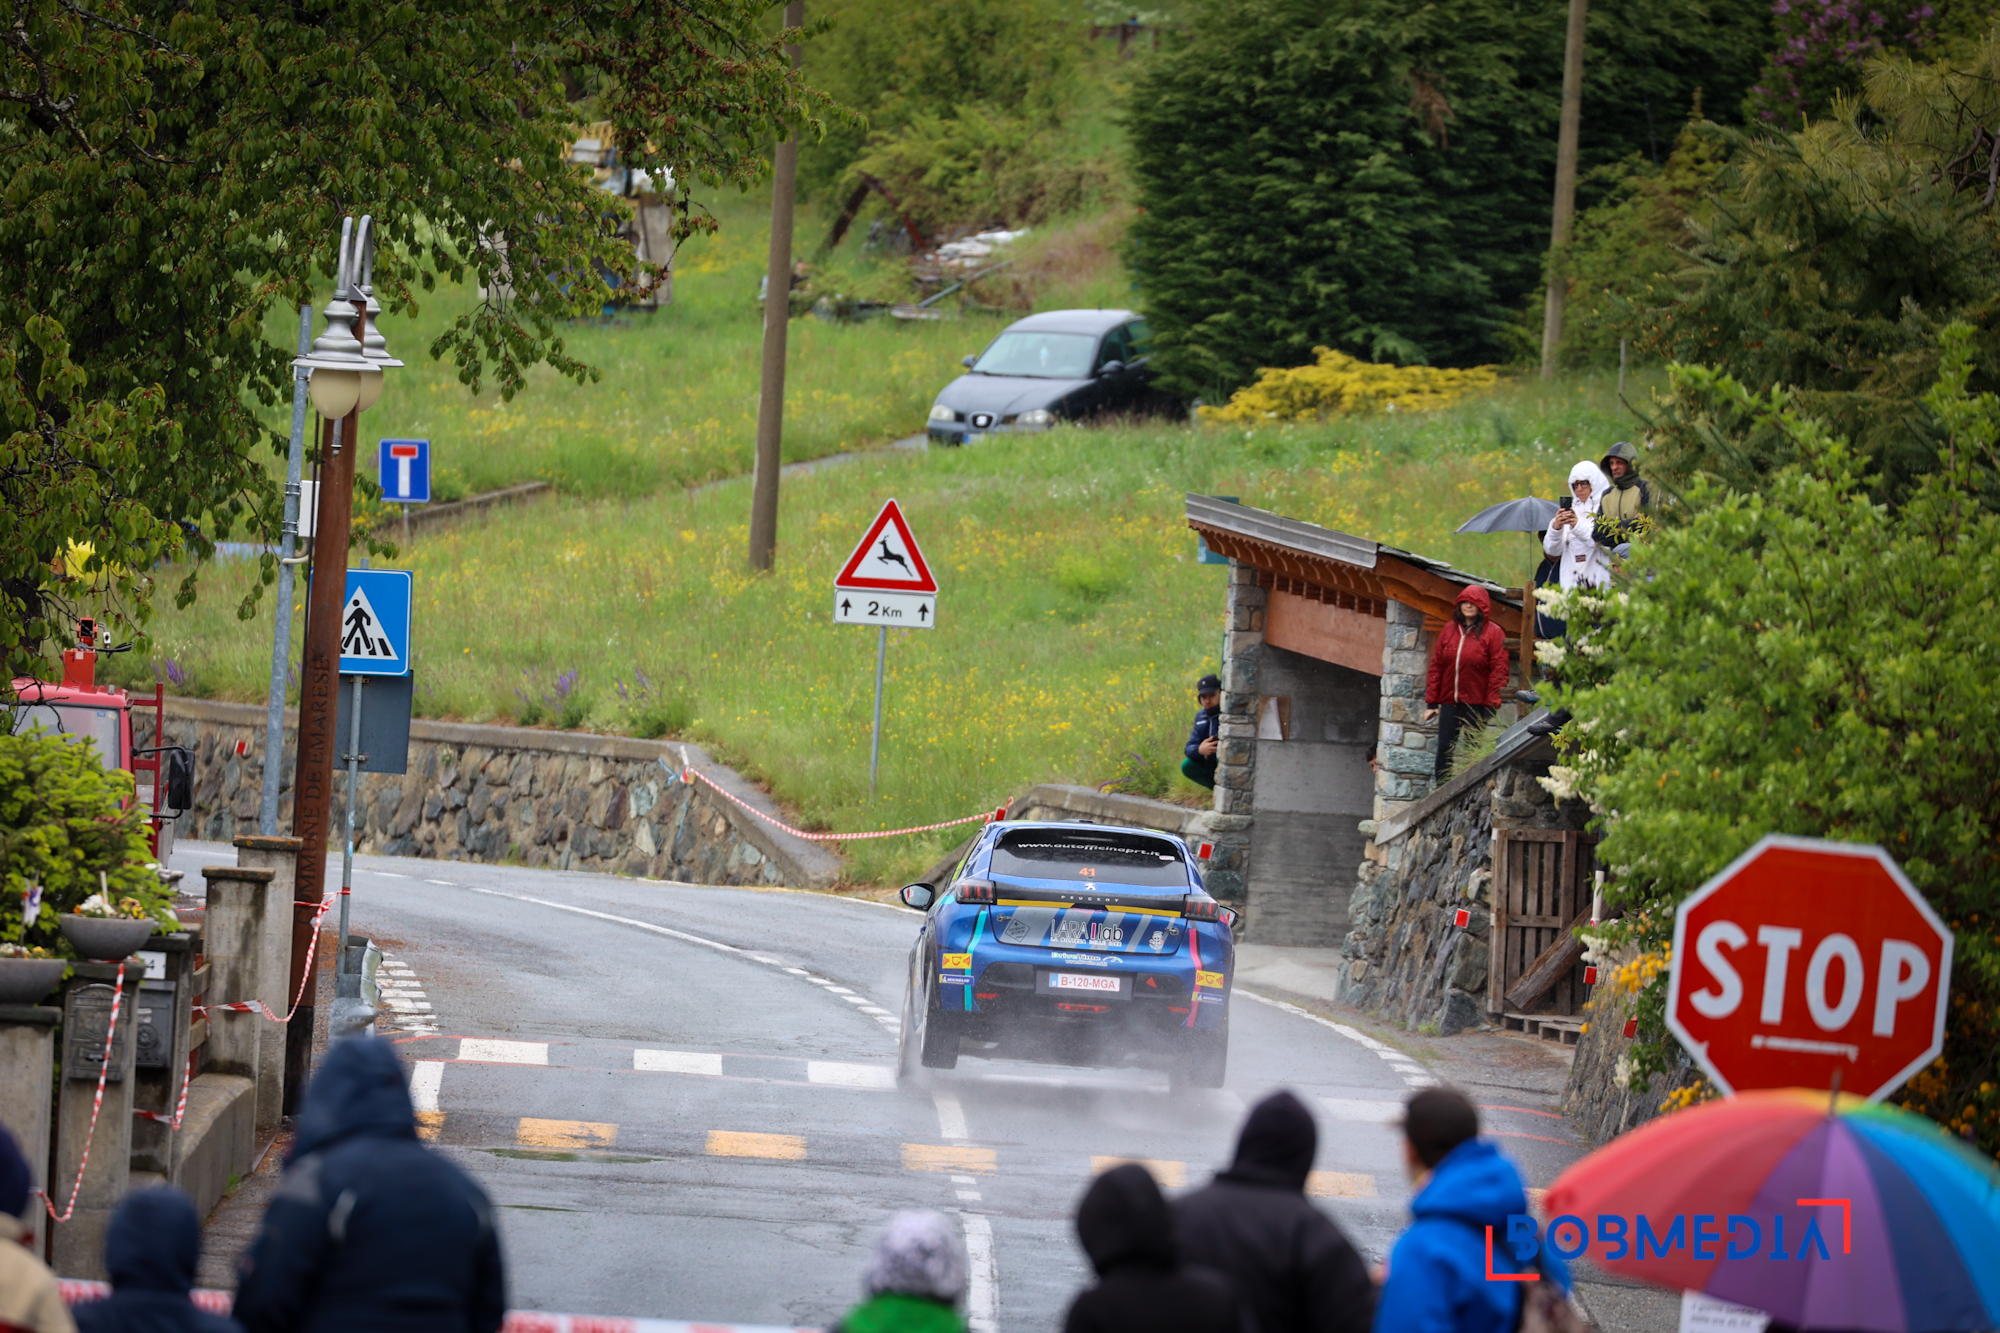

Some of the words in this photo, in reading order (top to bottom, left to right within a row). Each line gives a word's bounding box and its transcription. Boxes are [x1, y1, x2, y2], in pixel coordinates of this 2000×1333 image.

[868, 601, 879, 616] 2
[882, 606, 902, 618] Km
[307, 658, 330, 765] EMARESE
[305, 770, 323, 801] DE
[1017, 843, 1161, 857] www.autofficinaprt.it
[296, 806, 320, 926] COMMUNE
[1078, 867, 1096, 877] 41
[1061, 895, 1119, 903] PEUGEOT
[1060, 976, 1116, 989] B-120-MGA
[1690, 920, 1931, 1038] STOP
